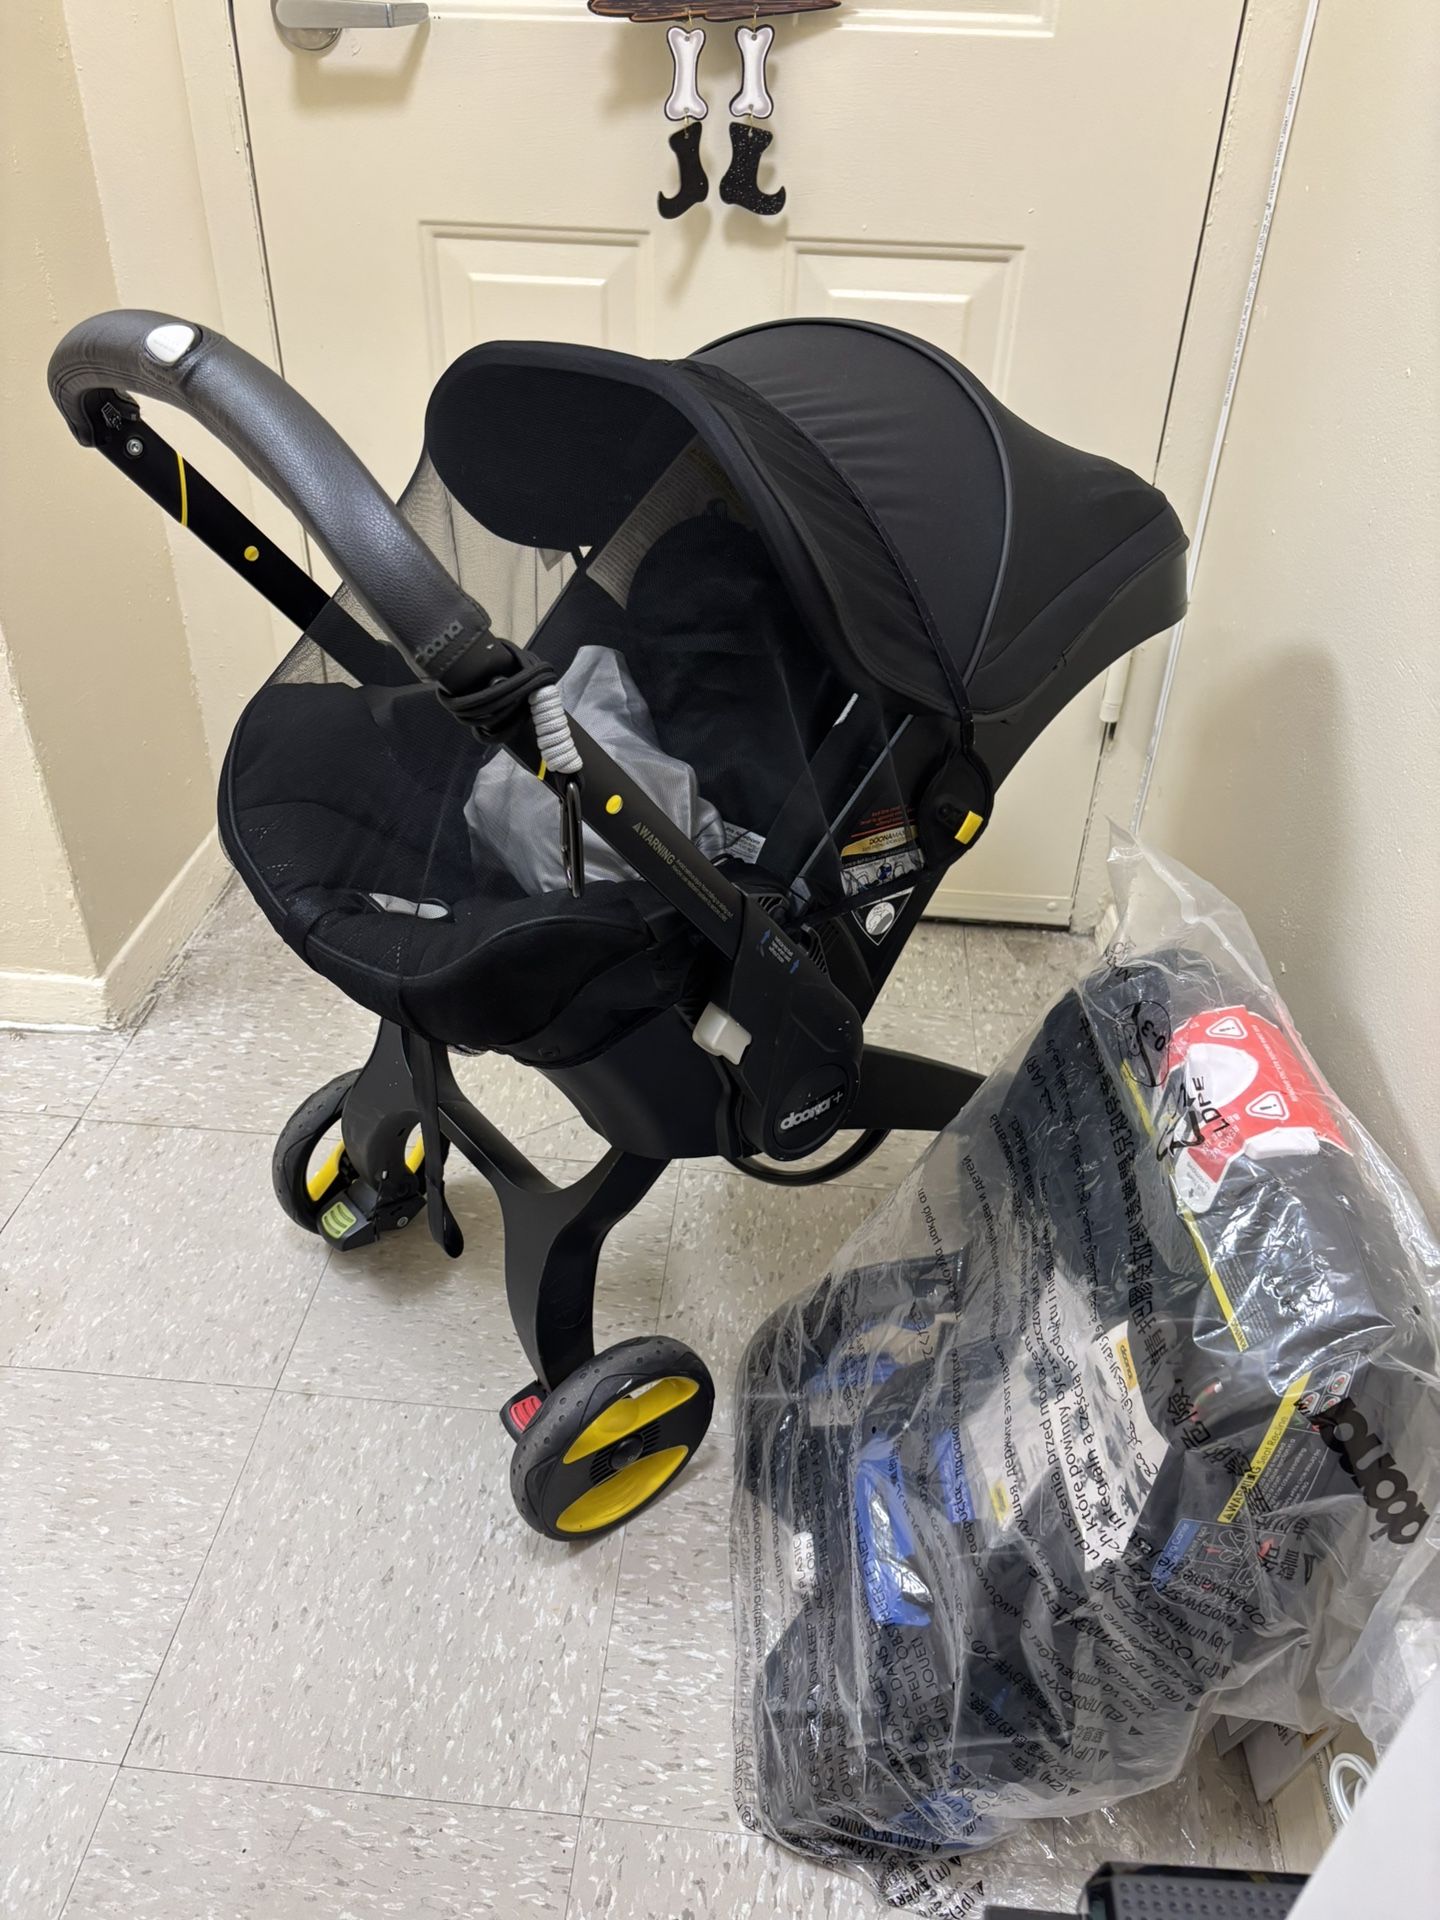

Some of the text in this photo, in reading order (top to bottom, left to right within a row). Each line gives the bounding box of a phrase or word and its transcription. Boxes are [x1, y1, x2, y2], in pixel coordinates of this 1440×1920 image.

[412, 619, 464, 664] doona
[637, 825, 676, 866] WARNING
[1137, 1017, 1169, 1053] 0-3
[1023, 1054, 1047, 1087] (AR)
[1187, 1073, 1229, 1134] LDPE
[959, 1153, 986, 1192] детей
[1046, 1302, 1080, 1374] produktu
[1019, 1334, 1048, 1414] montażem
[1047, 1371, 1069, 1402] być
[1000, 1386, 1011, 1413] этот
[1068, 1373, 1091, 1430] częścią
[999, 1416, 1019, 1477] держите
[1036, 1419, 1059, 1466] przed
[1054, 1405, 1082, 1477] powinny
[1046, 1464, 1101, 1563] uduszenia,
[1069, 1480, 1098, 1530] które
[794, 1537, 807, 1589] PLASTIC
[806, 1552, 814, 1569] OR
[1181, 1565, 1272, 1632] Opakowanie
[807, 1622, 816, 1653] KEEP
[864, 1617, 881, 1642] LES
[871, 1583, 908, 1661] OBSTRUER
[1145, 1594, 1210, 1643] uniknąć
[1205, 1630, 1231, 1655] Aby
[874, 1644, 903, 1691] DANS
[902, 1662, 923, 1701] PEUT
[866, 1669, 905, 1742] DANGER
[928, 1693, 949, 1721] UN
[1149, 1675, 1185, 1708] (RU)
[834, 1713, 849, 1748] AND
[895, 1693, 915, 1731] SAC
[1098, 1700, 1129, 1729] (EL)
[822, 1747, 832, 1763] IN
[909, 1731, 929, 1754] CE
[957, 1786, 976, 1803] EN
[1037, 1768, 1067, 1796] (ZH)
[825, 1811, 895, 1842] WARNING:
[926, 1860, 952, 1884] (IT)
